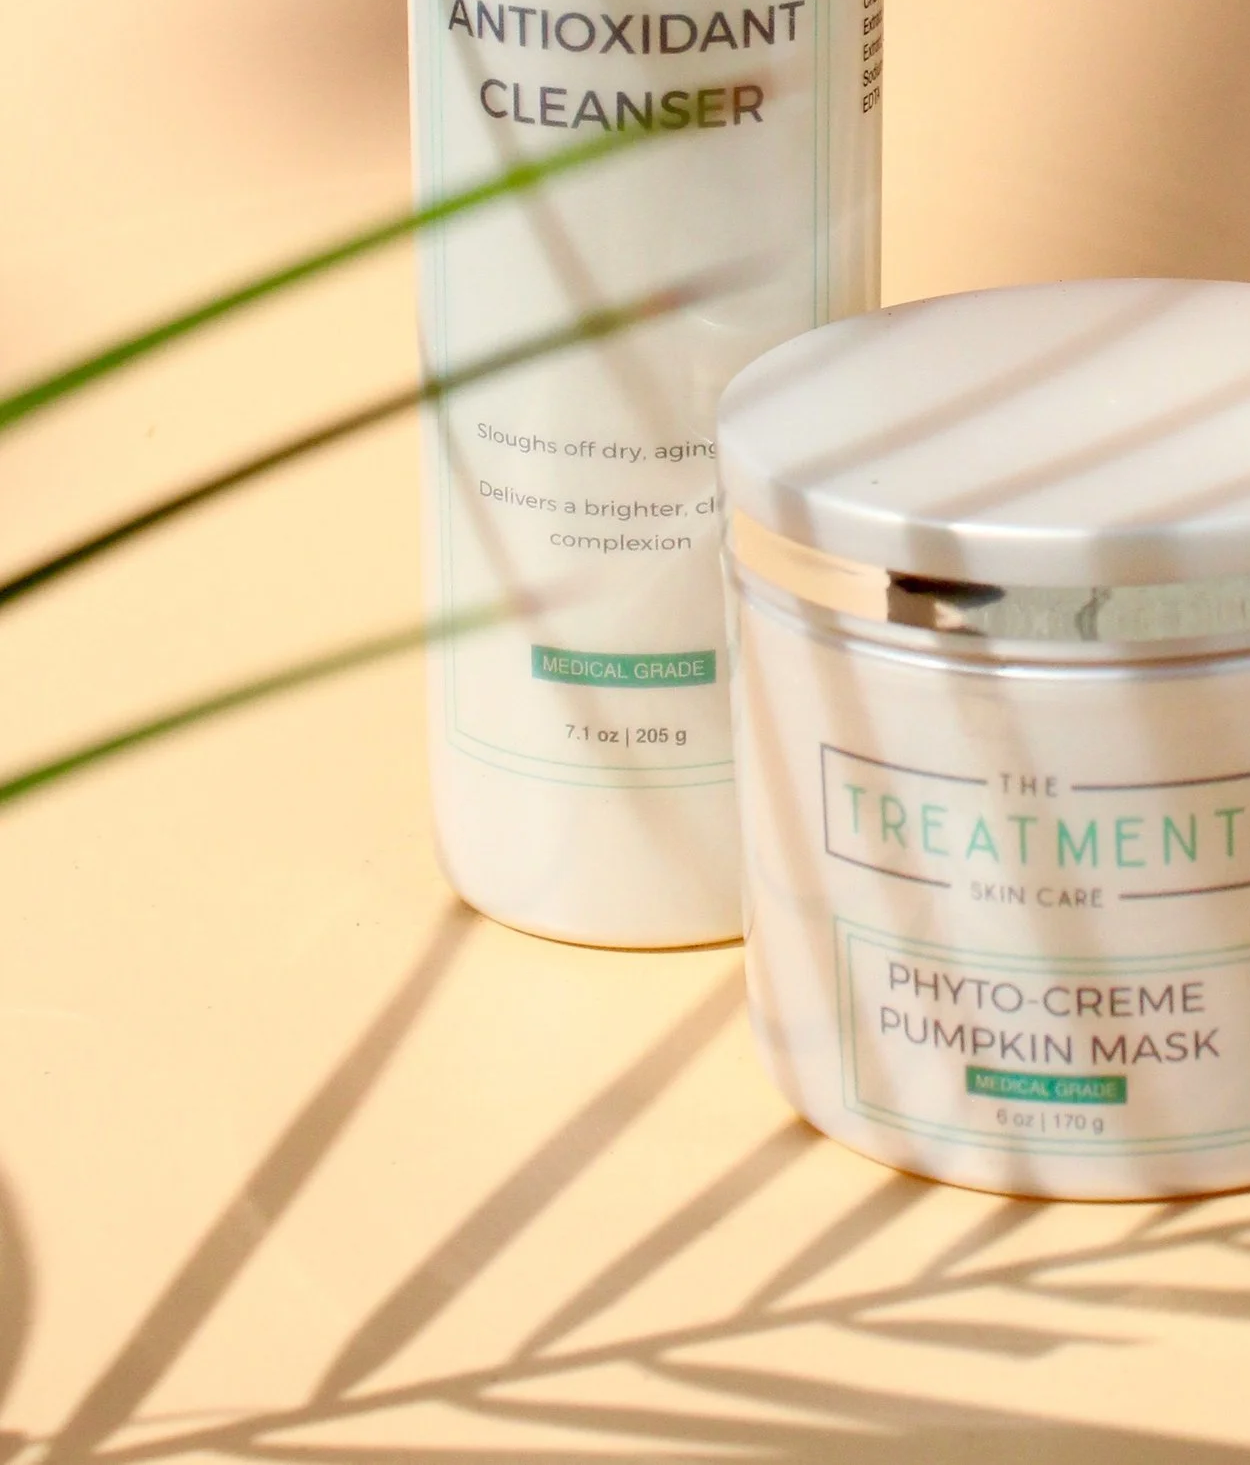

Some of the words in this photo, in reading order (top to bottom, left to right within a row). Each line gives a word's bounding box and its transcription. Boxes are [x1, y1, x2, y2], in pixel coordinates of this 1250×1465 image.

[479, 79, 765, 133] CLEANSER
[477, 422, 557, 453] Sloughs
[564, 440, 596, 458] off
[602, 442, 646, 463] dry,
[479, 479, 557, 512] Delivers
[564, 501, 577, 514] a
[584, 498, 688, 521] brighter,
[550, 533, 692, 554] complexion
[542, 654, 628, 680] MEDICAL
[634, 660, 705, 680] GRADE
[566, 724, 590, 741] 7.1
[597, 729, 619, 743] oz
[636, 728, 669, 744] 205
[675, 729, 687, 746] g
[1000, 773, 1059, 799] THE
[843, 783, 1245, 869] TREATMENT
[970, 881, 1026, 906] SKIN
[1036, 886, 1104, 909] CARE
[889, 960, 1205, 1018] PHYTO-CREME
[880, 1006, 1073, 1065] PUMPKIN
[1091, 1027, 1221, 1065] MASK
[974, 1073, 1050, 1098] MEDICAL
[1055, 1079, 1118, 1099] GRADE
[996, 1108, 1008, 1126] 6
[1012, 1113, 1035, 1128] oz
[1053, 1111, 1087, 1130] 170
[1091, 1116, 1105, 1135] g
